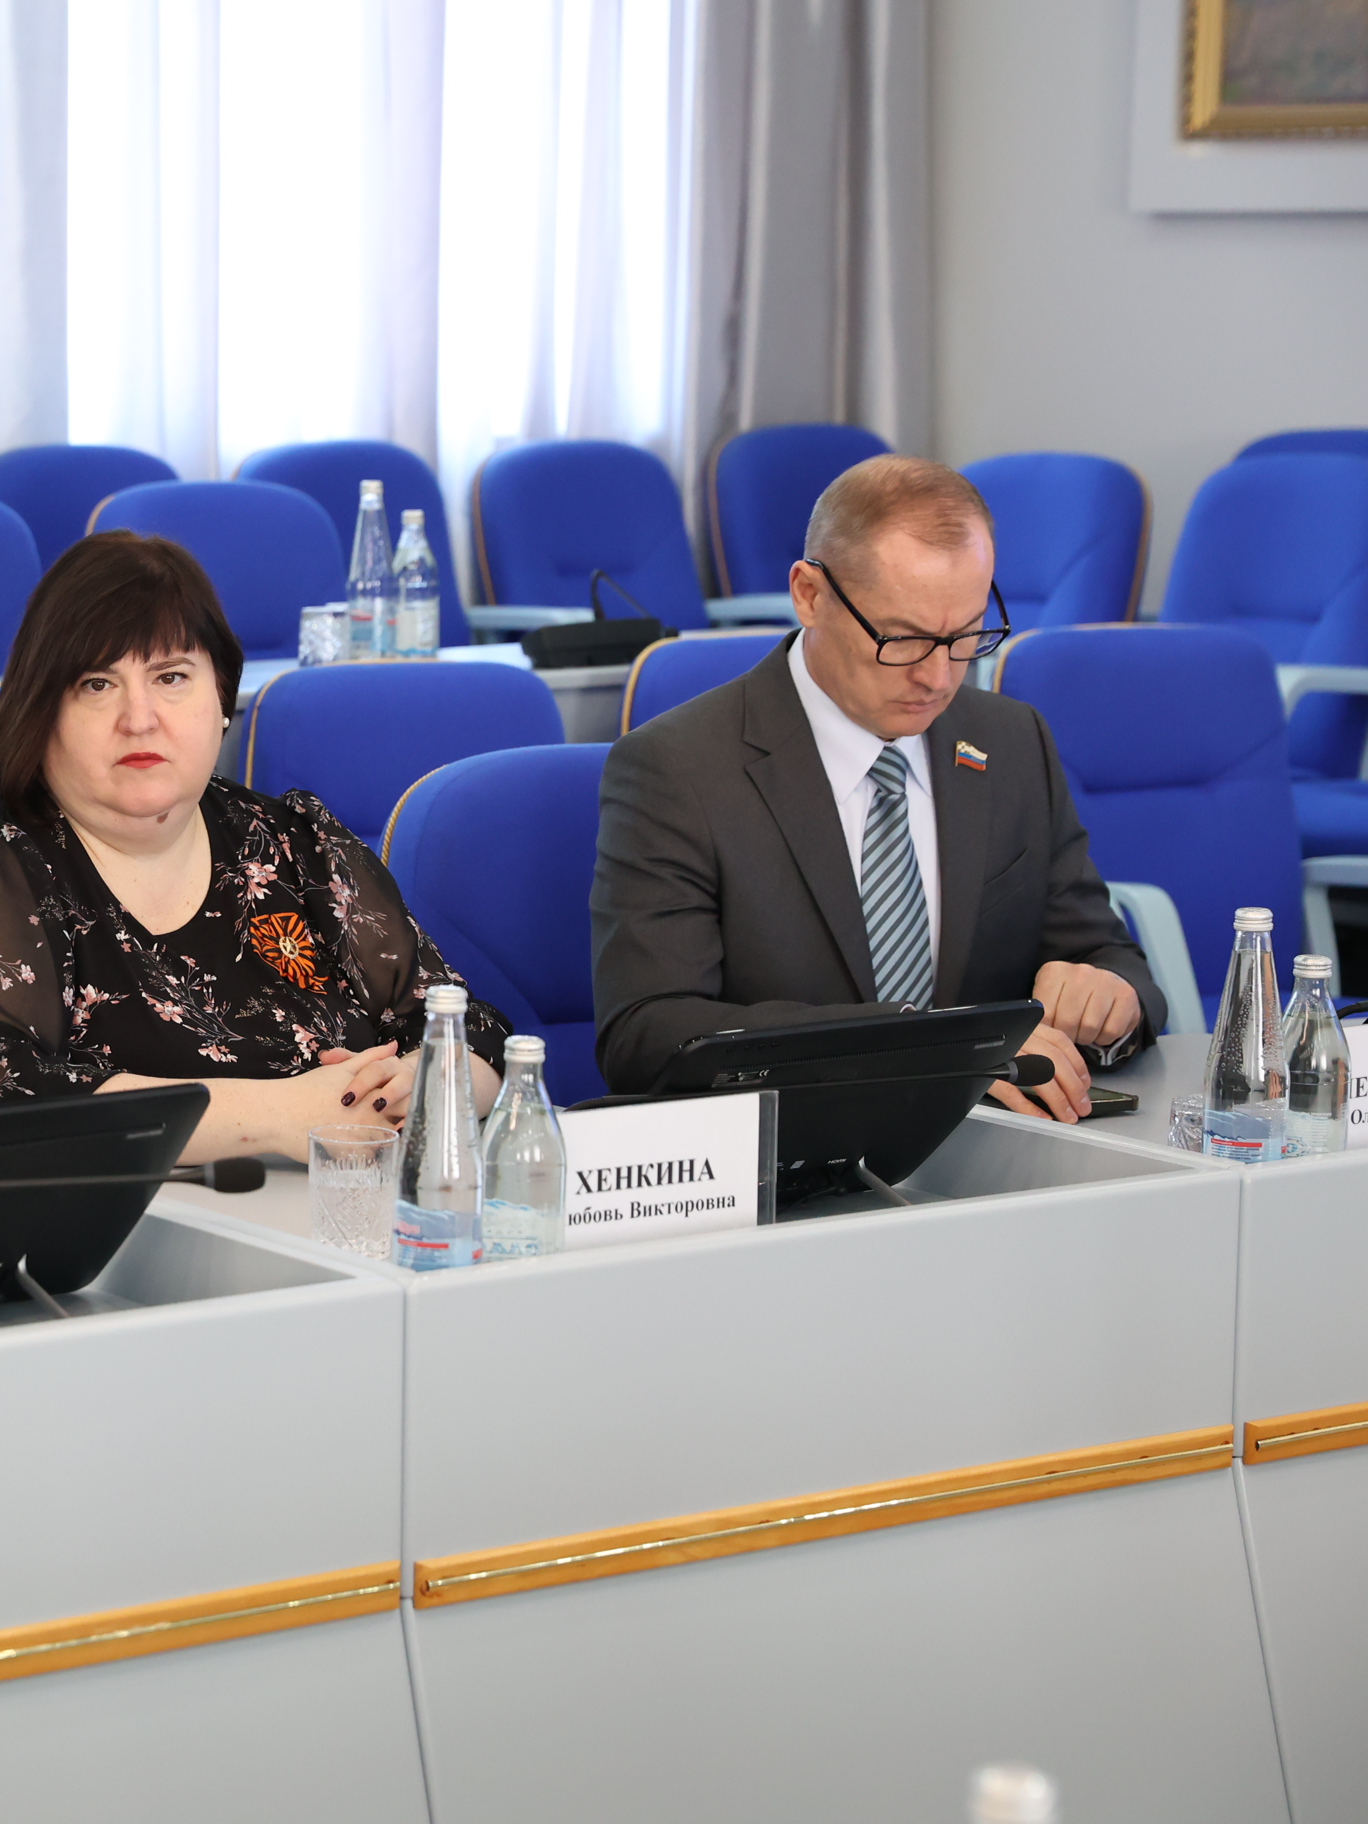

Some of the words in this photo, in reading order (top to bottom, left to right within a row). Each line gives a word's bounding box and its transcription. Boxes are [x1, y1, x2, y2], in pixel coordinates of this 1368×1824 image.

[575, 1157, 716, 1195] ХЕНКИНА
[568, 1206, 623, 1226] юбовь
[630, 1194, 736, 1220] Викторовна
